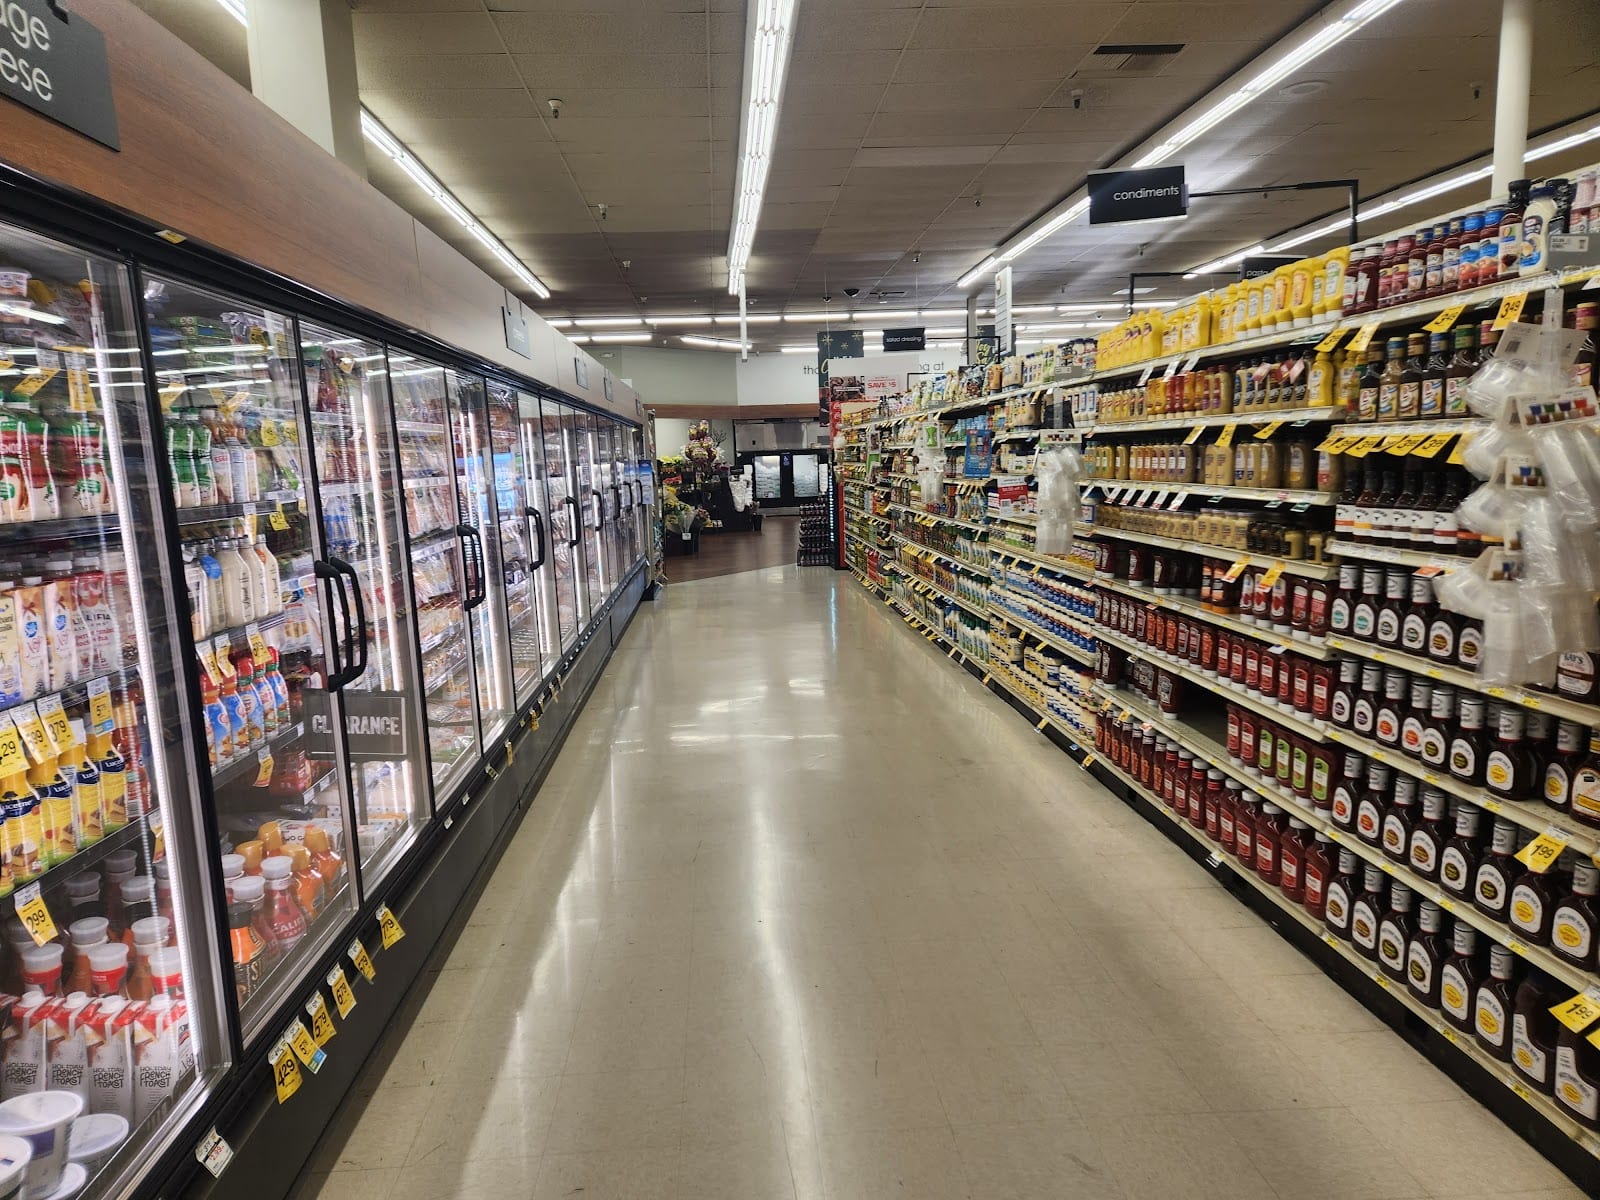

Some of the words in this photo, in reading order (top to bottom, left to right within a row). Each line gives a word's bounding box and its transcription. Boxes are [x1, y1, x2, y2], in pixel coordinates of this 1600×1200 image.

[0, 1, 50, 51] ge
[0, 48, 52, 102] ese
[1113, 185, 1180, 201] condiments
[933, 361, 944, 371] at
[867, 381, 887, 389] SAVE
[0, 740, 16, 766] 29
[1529, 843, 1555, 859] 199
[26, 909, 46, 935] 299
[1565, 1003, 1594, 1020] 199
[278, 1059, 296, 1087] 429
